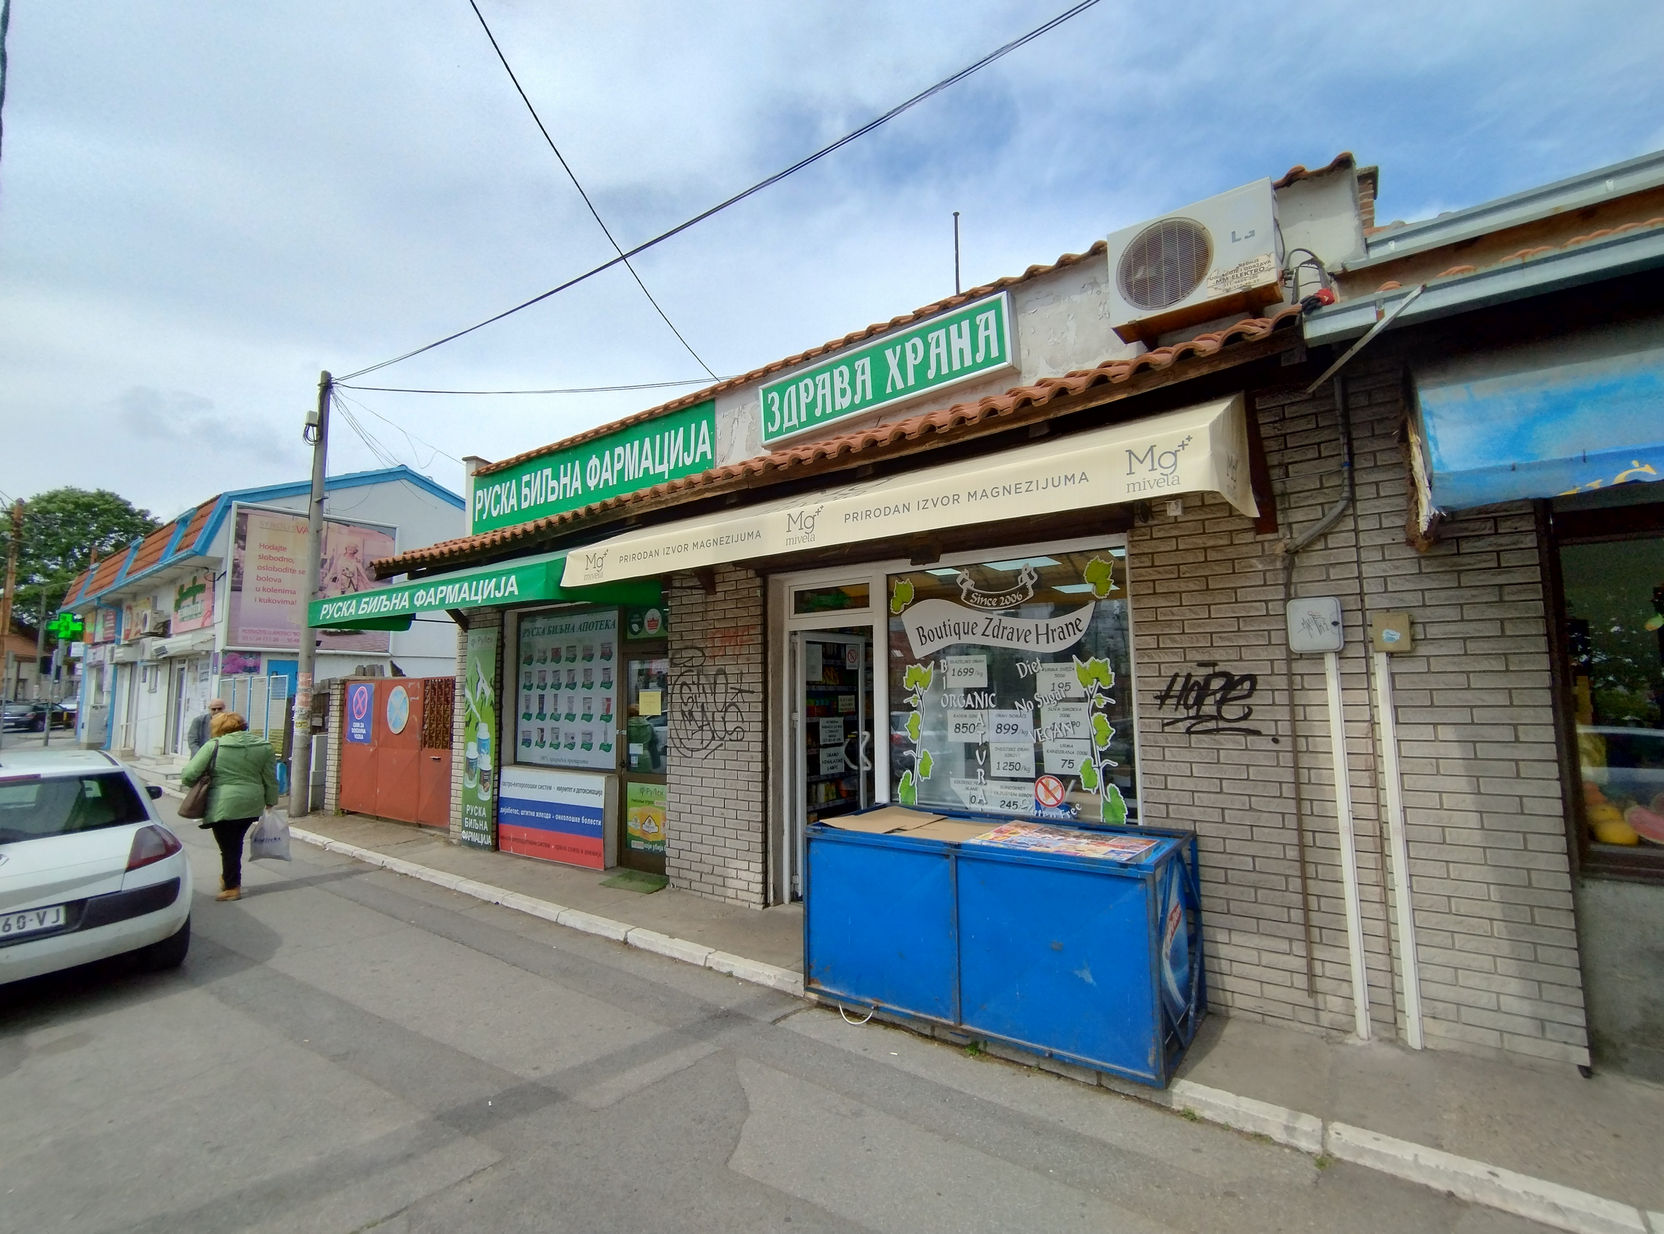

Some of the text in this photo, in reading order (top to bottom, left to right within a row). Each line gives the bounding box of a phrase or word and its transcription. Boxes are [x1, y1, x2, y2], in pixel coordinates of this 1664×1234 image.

[767, 308, 1000, 434] ЗДРАВА ХРАНА
[474, 418, 713, 523] РУСКА БИЉНА ФАРМАЦИЈА
[1126, 474, 1181, 494] mivela
[843, 471, 1090, 524] PRIRODAN IZVOR MAGNEZIJUMA
[618, 529, 763, 565] PRIRODAN IZVOR MAGNEZIJUMA
[785, 531, 817, 547] mivela
[258, 543, 288, 554] Hodajte
[257, 553, 296, 565] slobodno,
[256, 564, 297, 575] oslobodite
[255, 574, 283, 584] bolova
[262, 587, 297, 596] kolenima
[319, 574, 519, 621] РУСКА БИЉНА ФАРМАЦИЈА
[970, 591, 1024, 607] Since 2006
[258, 597, 298, 607] kukovima!
[576, 619, 616, 634] АПОТЕКА
[915, 615, 1084, 647] Boutique Zdrave Hrane
[1015, 656, 1043, 679] Diet
[940, 690, 998, 710] ORGANIC
[1014, 688, 1067, 716] No Sugar
[1060, 758, 1075, 769] 75
[466, 804, 487, 818] РУСКА
[1000, 799, 1019, 810] 245
[464, 816, 489, 832] БИЉНА
